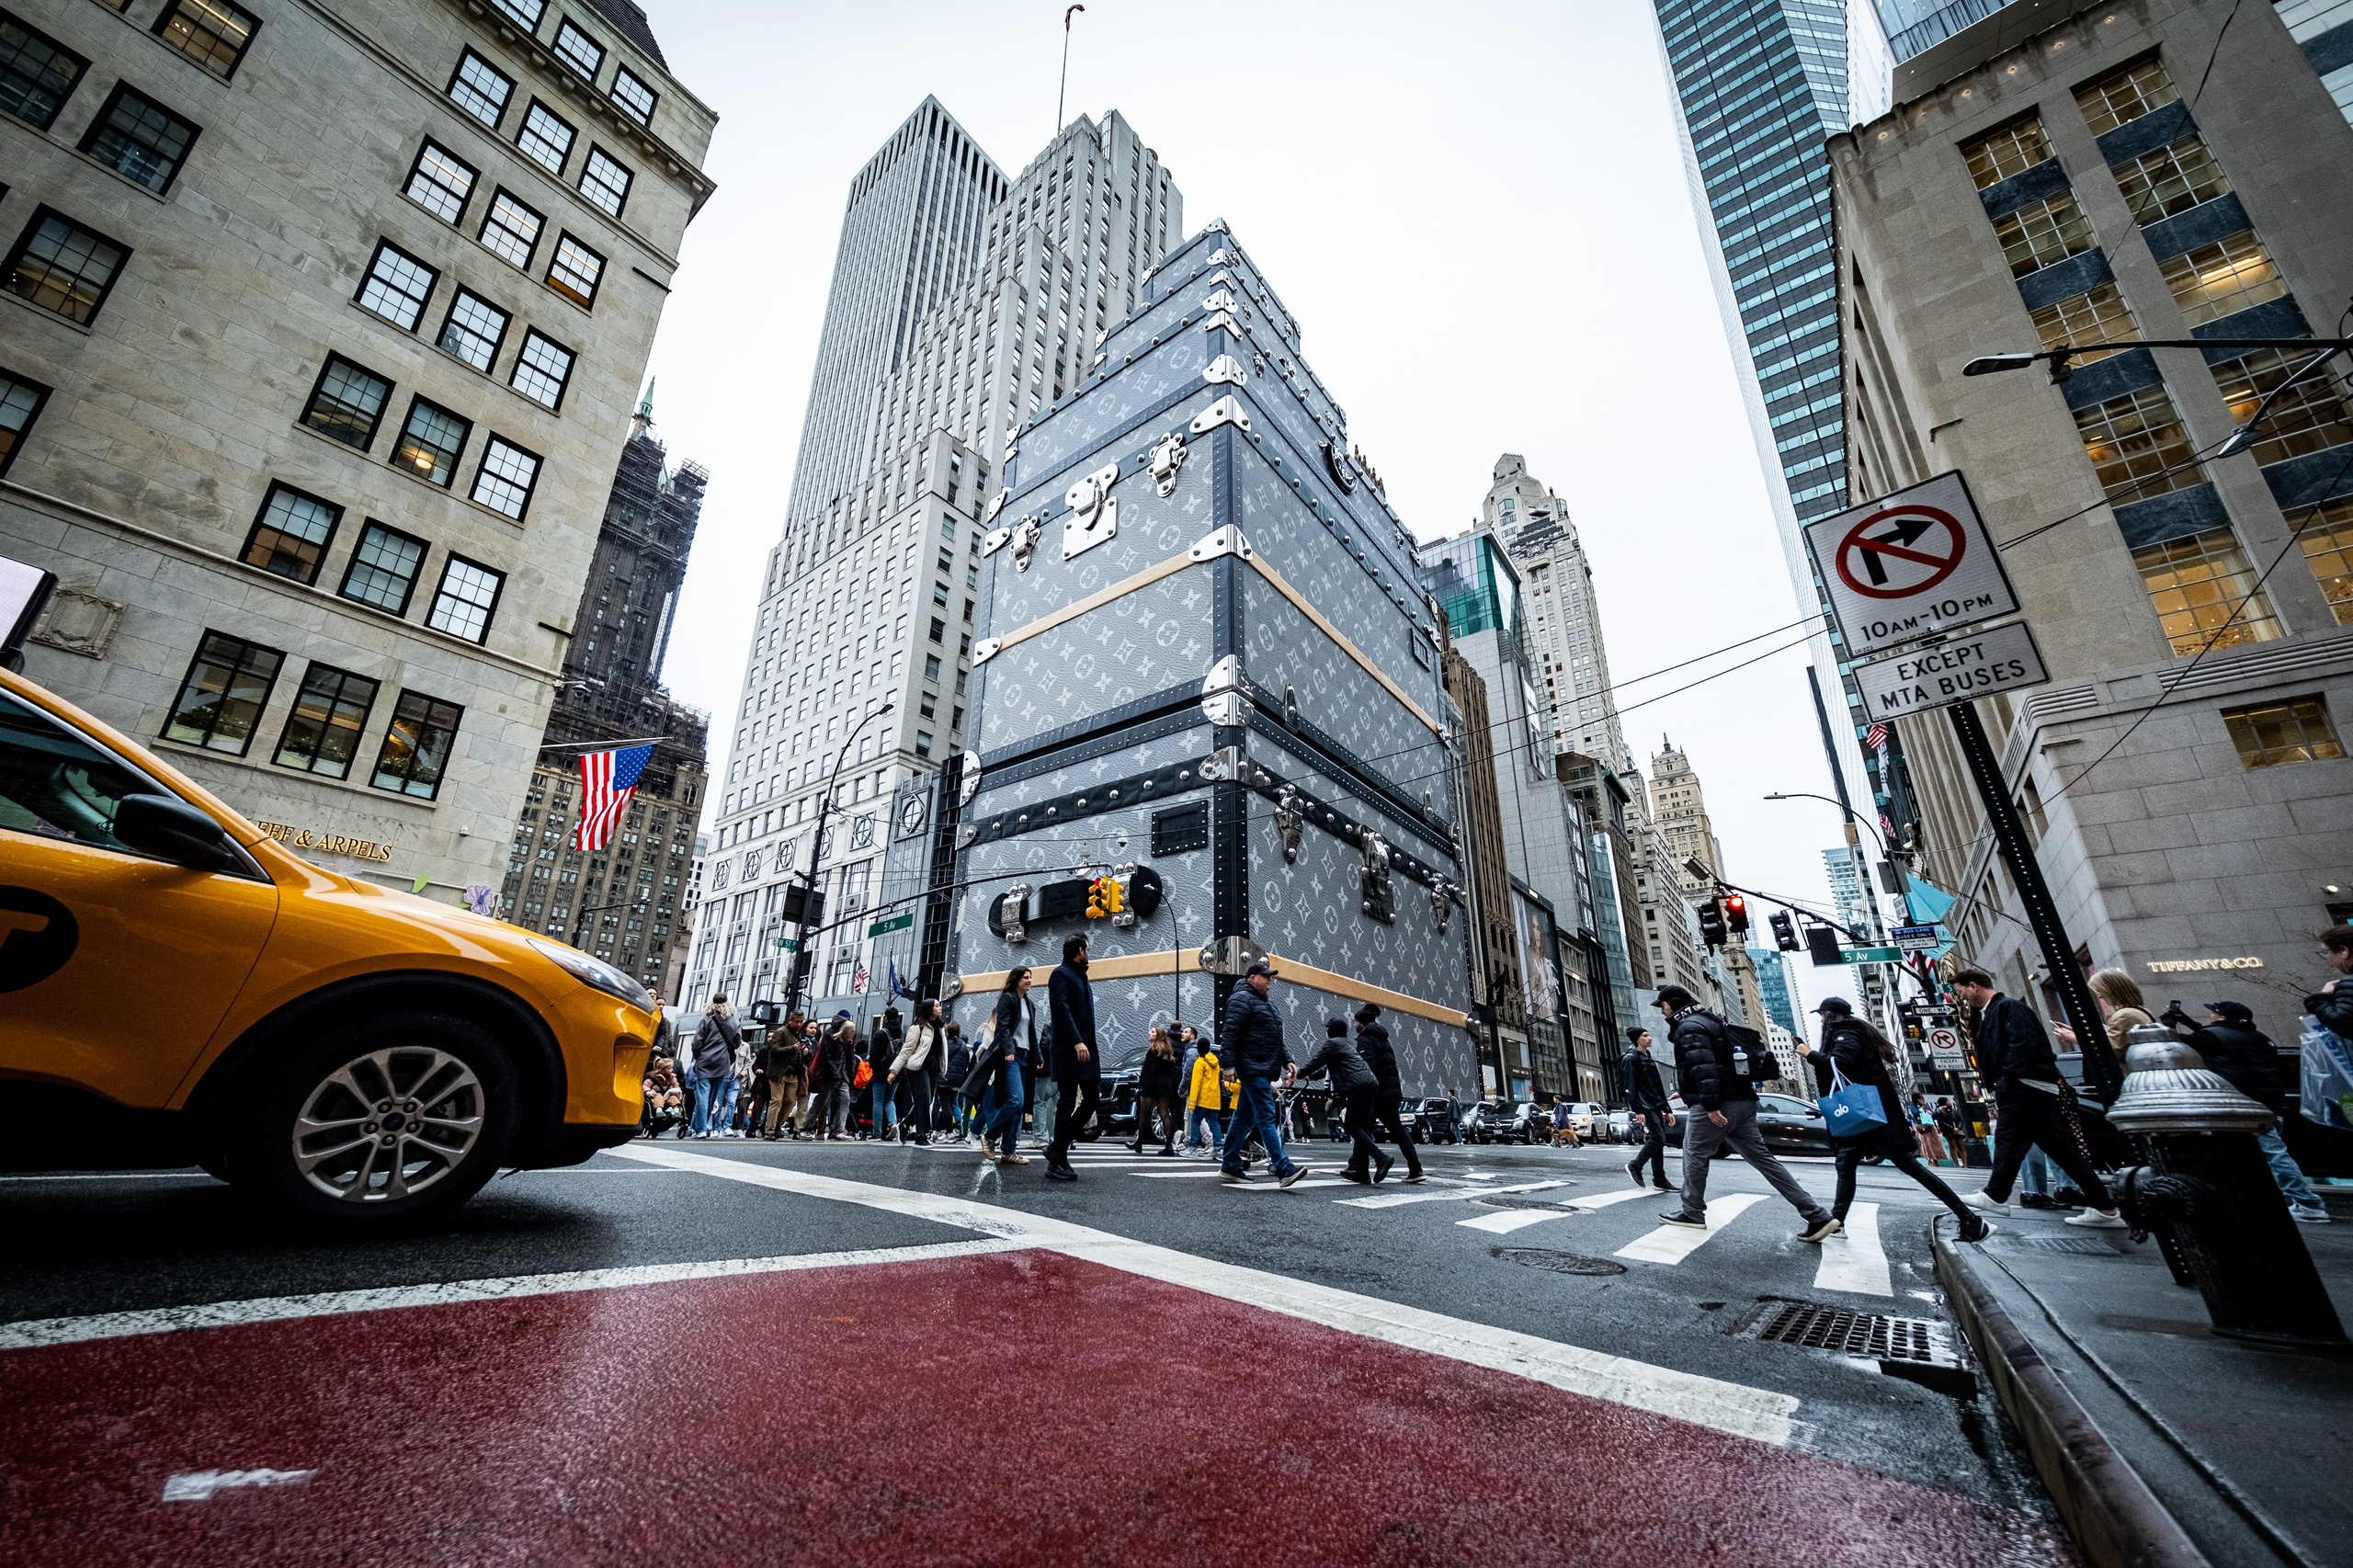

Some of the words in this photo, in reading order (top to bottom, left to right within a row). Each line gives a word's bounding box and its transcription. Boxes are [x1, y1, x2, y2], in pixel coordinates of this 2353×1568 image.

[1896, 642, 1985, 682] EXCEPT
[1881, 684, 1930, 710] MTA
[1938, 659, 2027, 696] BUSES
[296, 829, 314, 846] &
[315, 834, 392, 861] ARPELS
[883, 922, 889, 932] 5
[1844, 952, 1852, 961] 5
[1856, 951, 1868, 961] Av
[1834, 1103, 1849, 1118] alo
